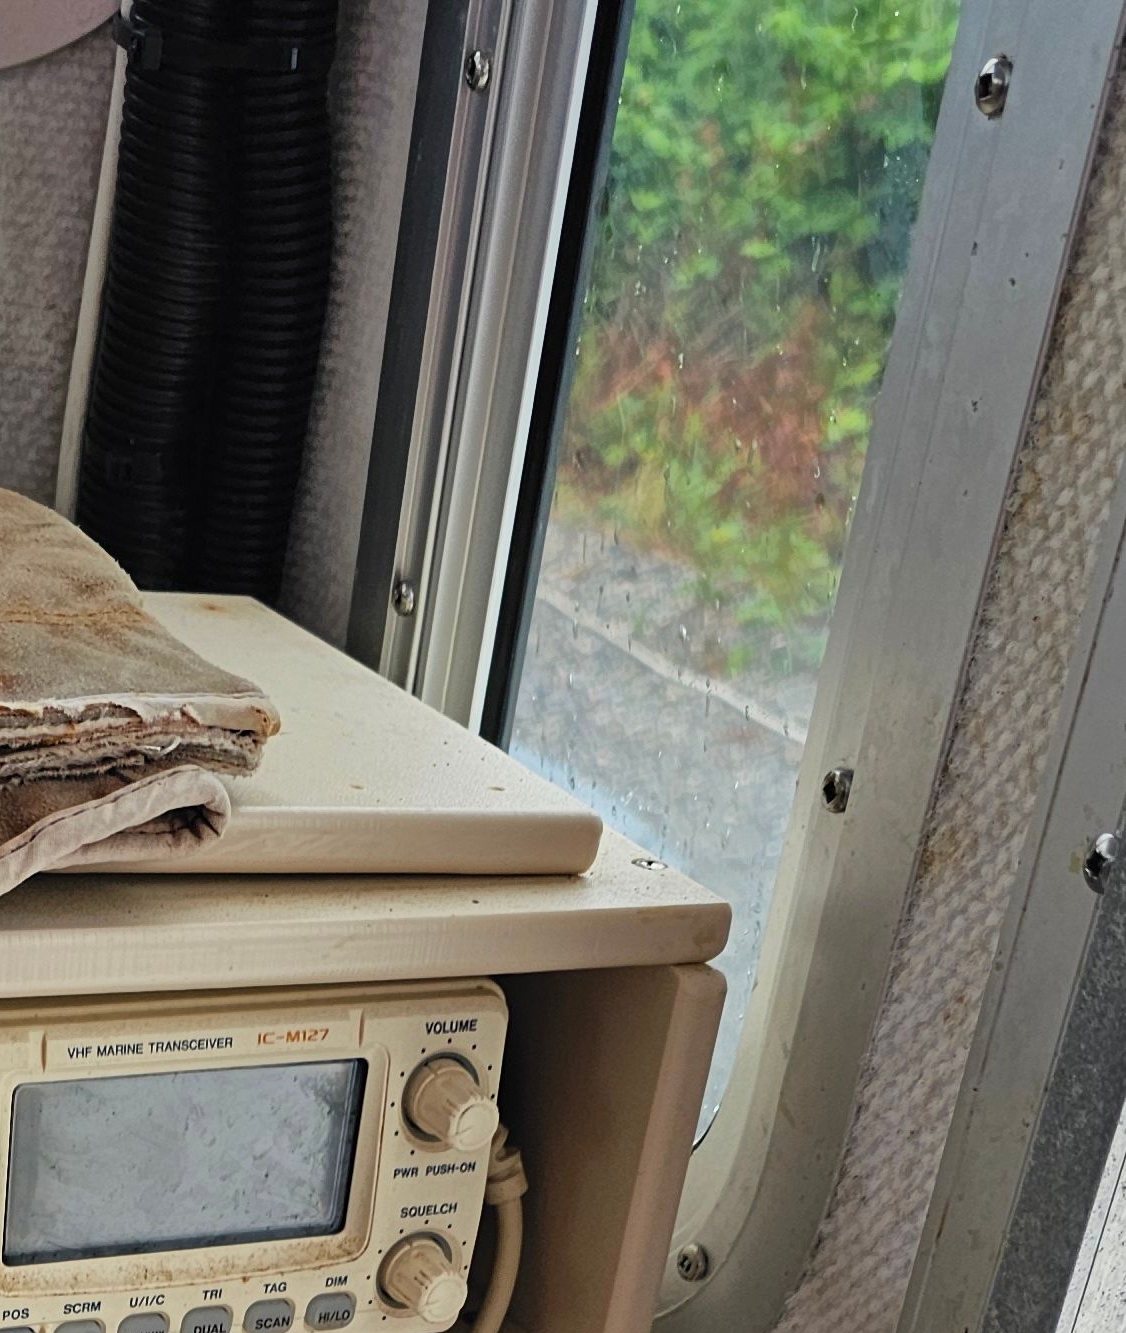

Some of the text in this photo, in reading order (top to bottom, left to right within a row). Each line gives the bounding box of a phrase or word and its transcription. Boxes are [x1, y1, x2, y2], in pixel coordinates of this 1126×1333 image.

[425, 1018, 478, 1035] VOLUME
[257, 1028, 330, 1046] IC-M127
[67, 1036, 234, 1060] VHF MARINE TRANSCEIVER
[393, 1161, 476, 1180] PWR PUSH-ON
[400, 1201, 457, 1219] SQUELCH
[263, 1280, 287, 1295] TAG
[325, 1274, 348, 1289] DIM
[129, 1294, 165, 1309] U/I/C
[202, 1288, 223, 1301] TRI
[2, 1308, 30, 1322] POS
[63, 1301, 102, 1316] SCRM
[318, 1308, 351, 1326] HI/LO
[255, 1313, 291, 1330] SCAN
